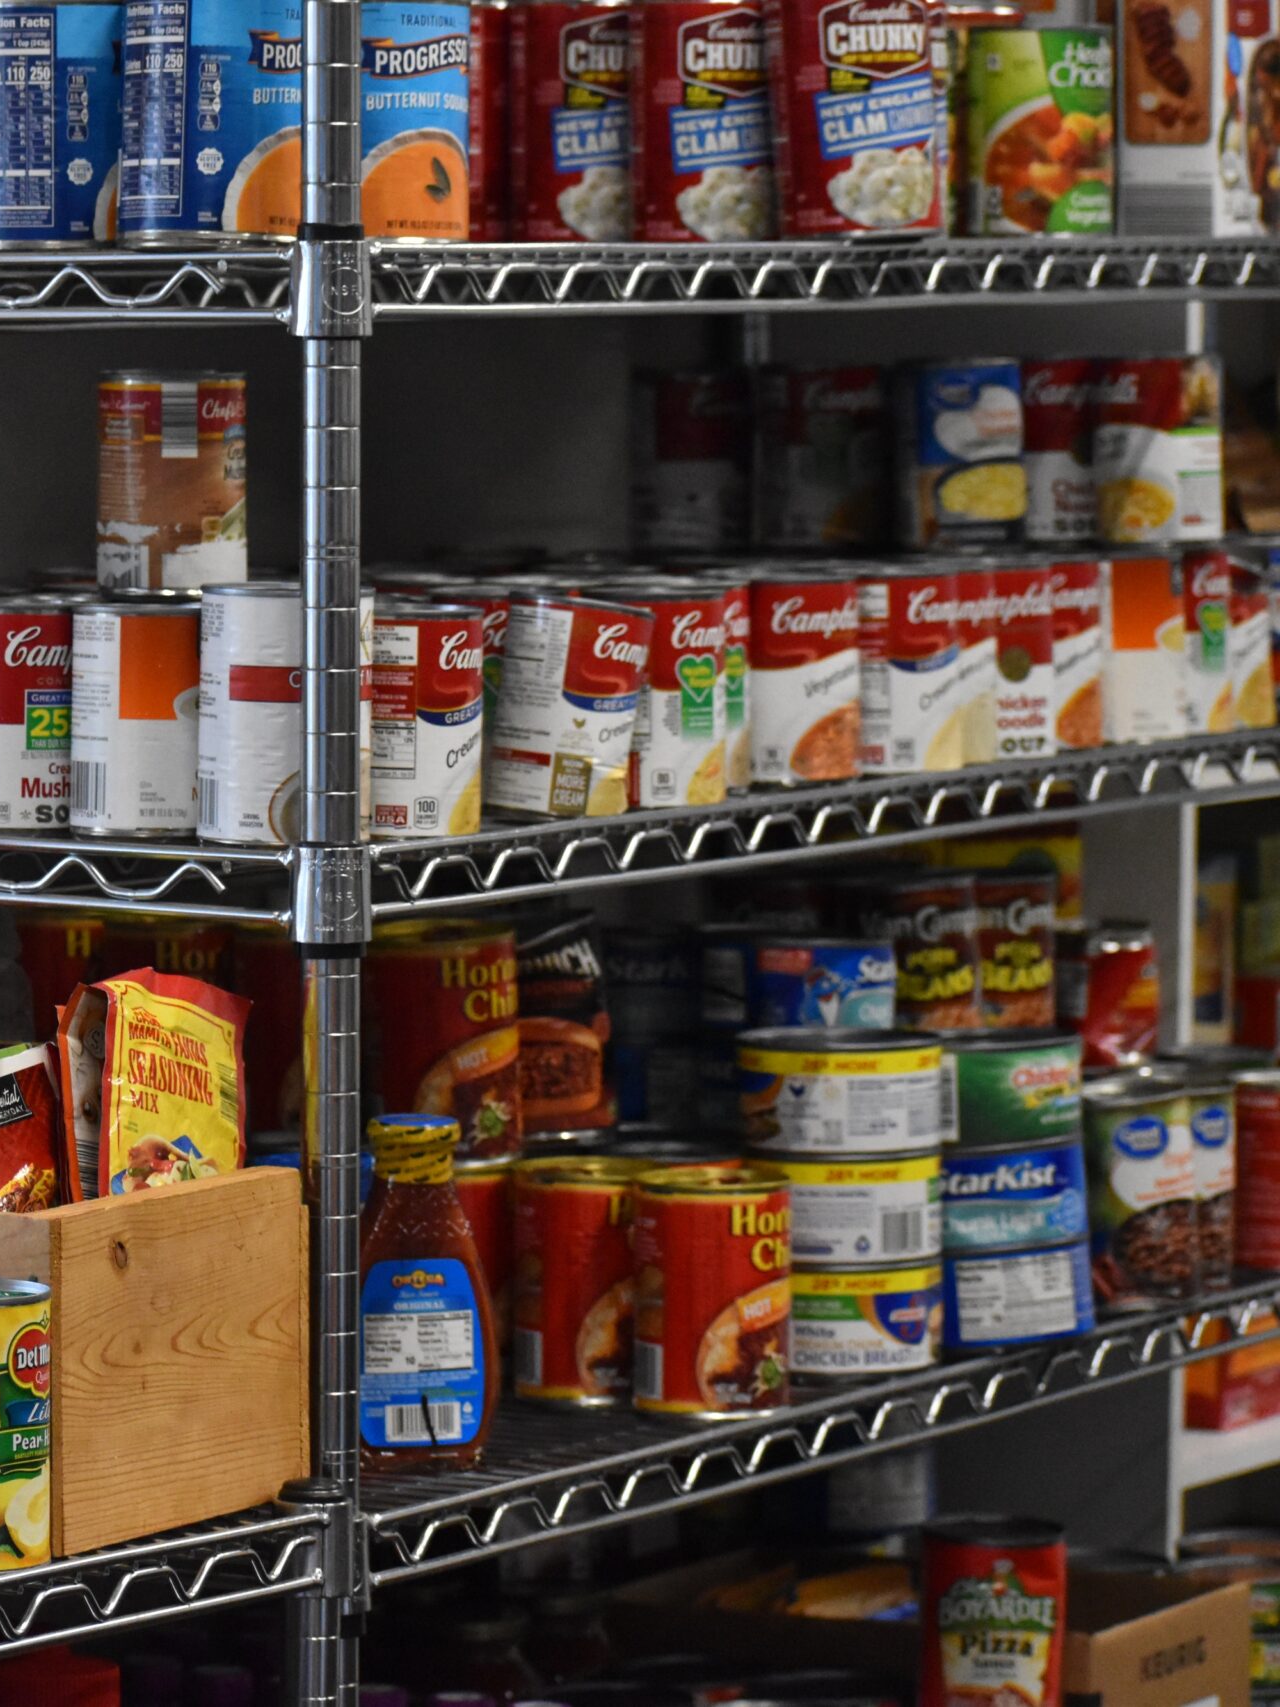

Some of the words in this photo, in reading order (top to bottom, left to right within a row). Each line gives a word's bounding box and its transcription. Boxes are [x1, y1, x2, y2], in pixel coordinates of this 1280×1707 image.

[158, 4, 184, 15] Facts
[20, 16, 50, 28] Facts
[827, 22, 926, 56] CHUNKY
[145, 55, 161, 69] 110
[164, 54, 184, 68] 250
[375, 38, 468, 75] PROGRESSO
[6, 68, 26, 81] 110
[29, 67, 51, 81] 250
[365, 92, 441, 112] BUTTERNUT
[823, 111, 888, 143] CLAM
[557, 129, 619, 158] CLAM
[675, 128, 740, 158] CLAM
[31, 694, 62, 703] GREAT
[30, 708, 70, 737] 25
[21, 775, 71, 799] Mush
[34, 804, 71, 824] SO
[417, 800, 436, 814] 100
[127, 1047, 214, 1107] SEASONING
[129, 1087, 160, 1115] MIX
[393, 1300, 446, 1311] ORIGINAL
[16, 1346, 38, 1370] Del
[12, 1433, 43, 1453] Pear
[958, 1629, 1035, 1656] Pizza
